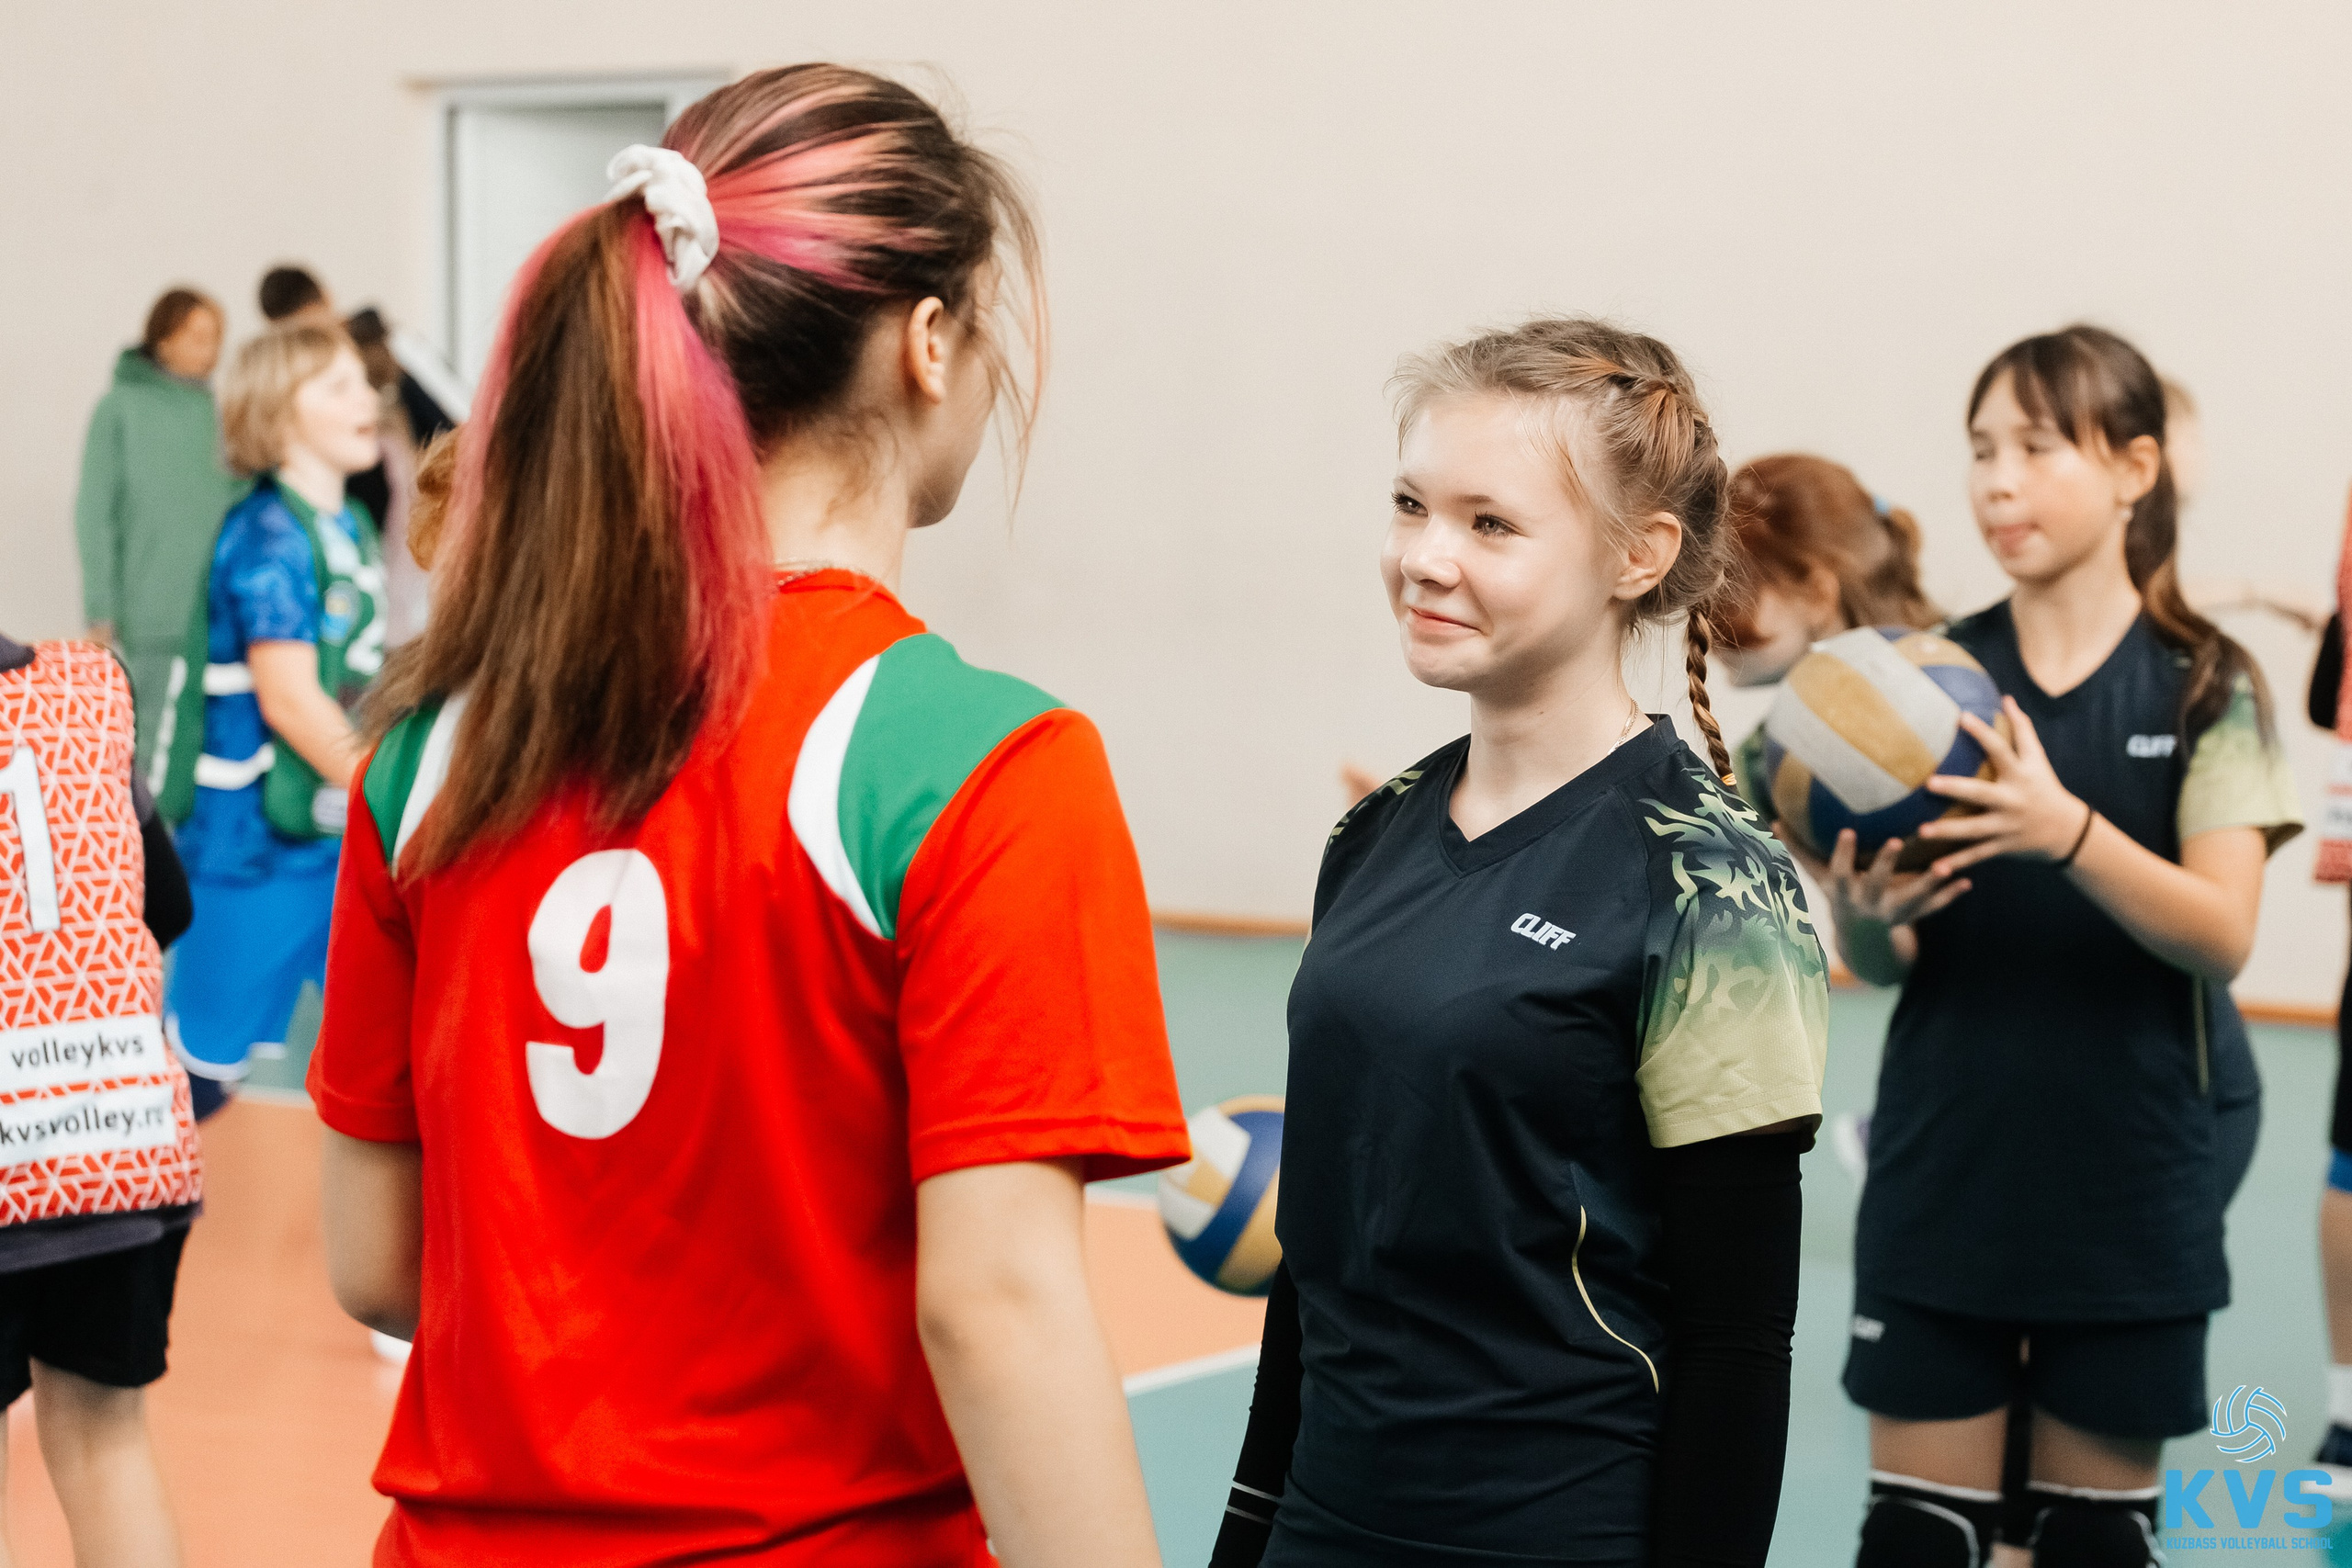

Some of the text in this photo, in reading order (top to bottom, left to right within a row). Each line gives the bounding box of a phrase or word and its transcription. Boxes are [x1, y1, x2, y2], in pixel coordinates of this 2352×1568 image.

[0, 745, 62, 933] 1
[1510, 912, 1577, 951] CLIFF
[11, 1032, 144, 1069] volleykvs
[526, 848, 670, 1140] 9
